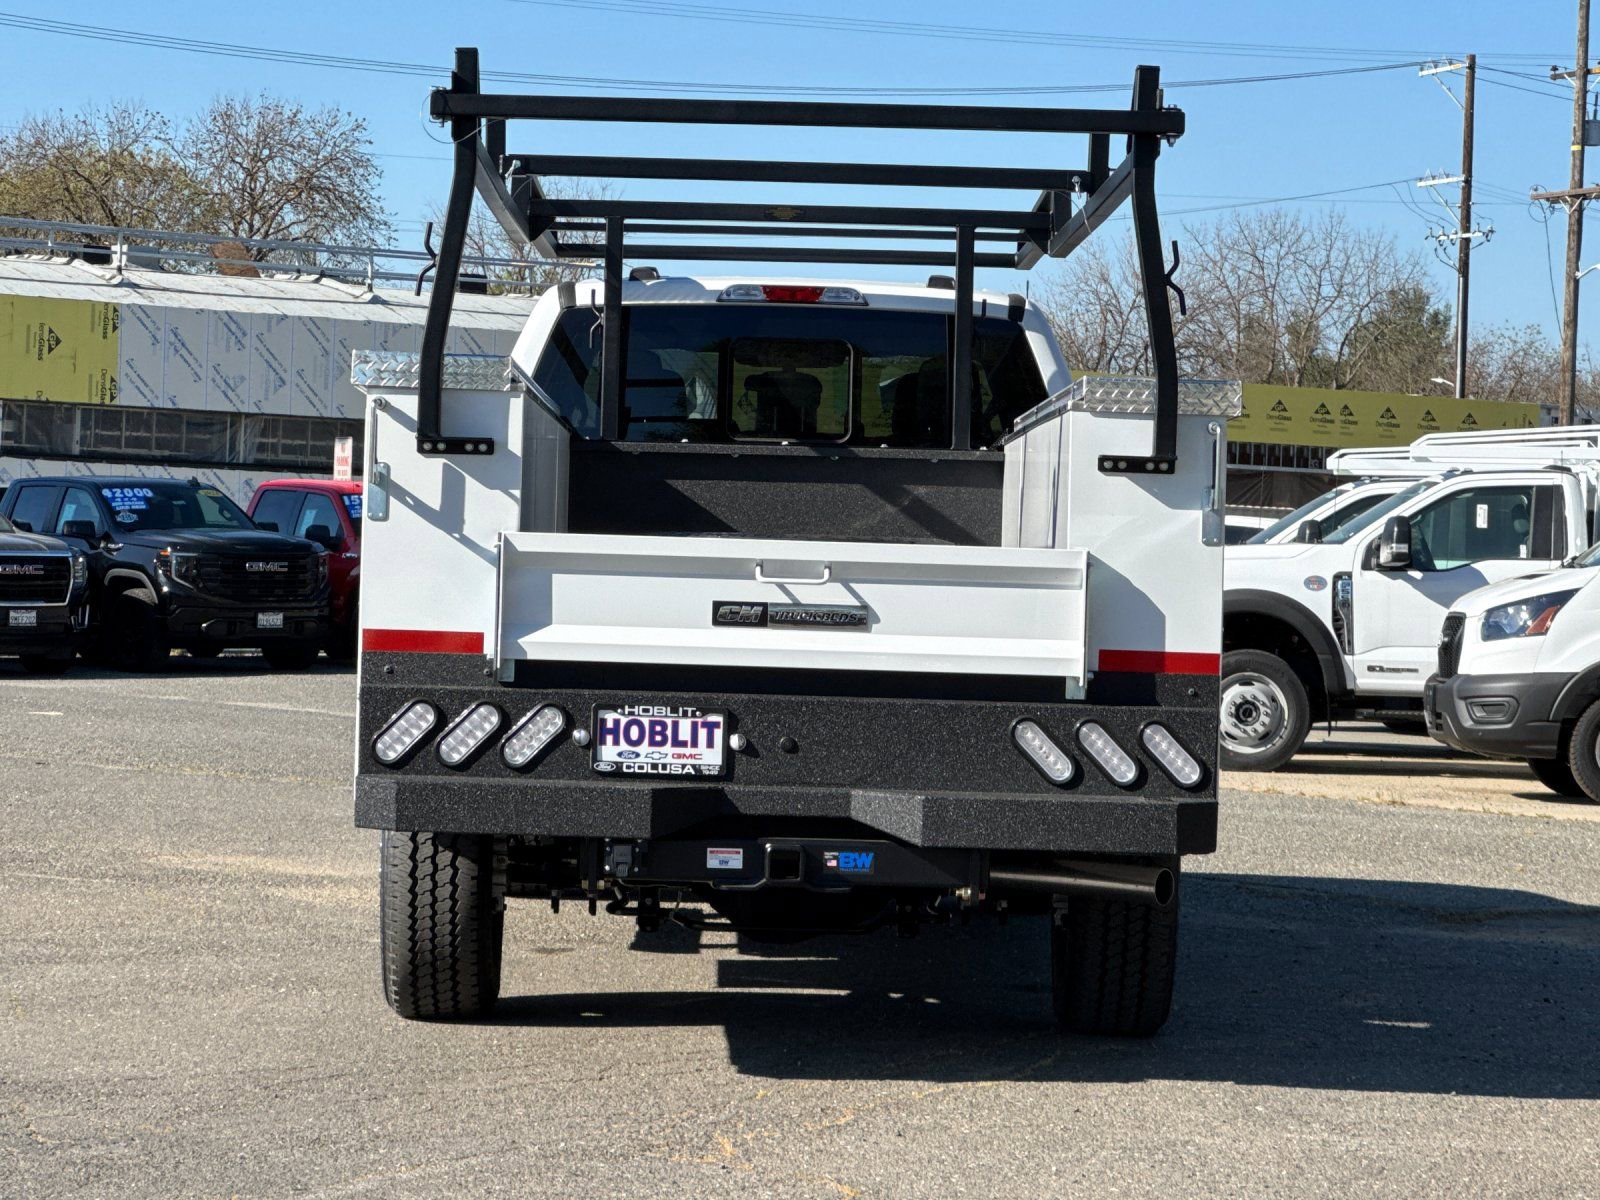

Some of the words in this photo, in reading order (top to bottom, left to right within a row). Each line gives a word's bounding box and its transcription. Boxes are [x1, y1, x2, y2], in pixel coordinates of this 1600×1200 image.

[0, 564, 45, 575] GMC
[246, 561, 289, 572] GMC
[716, 605, 764, 623] CM
[775, 611, 819, 622] TRUCK
[820, 612, 860, 623] BEDS
[624, 705, 697, 717] HOBLIT
[598, 717, 722, 750] HOBLIT
[620, 750, 637, 759] Ford
[622, 762, 696, 775] COLUSA
